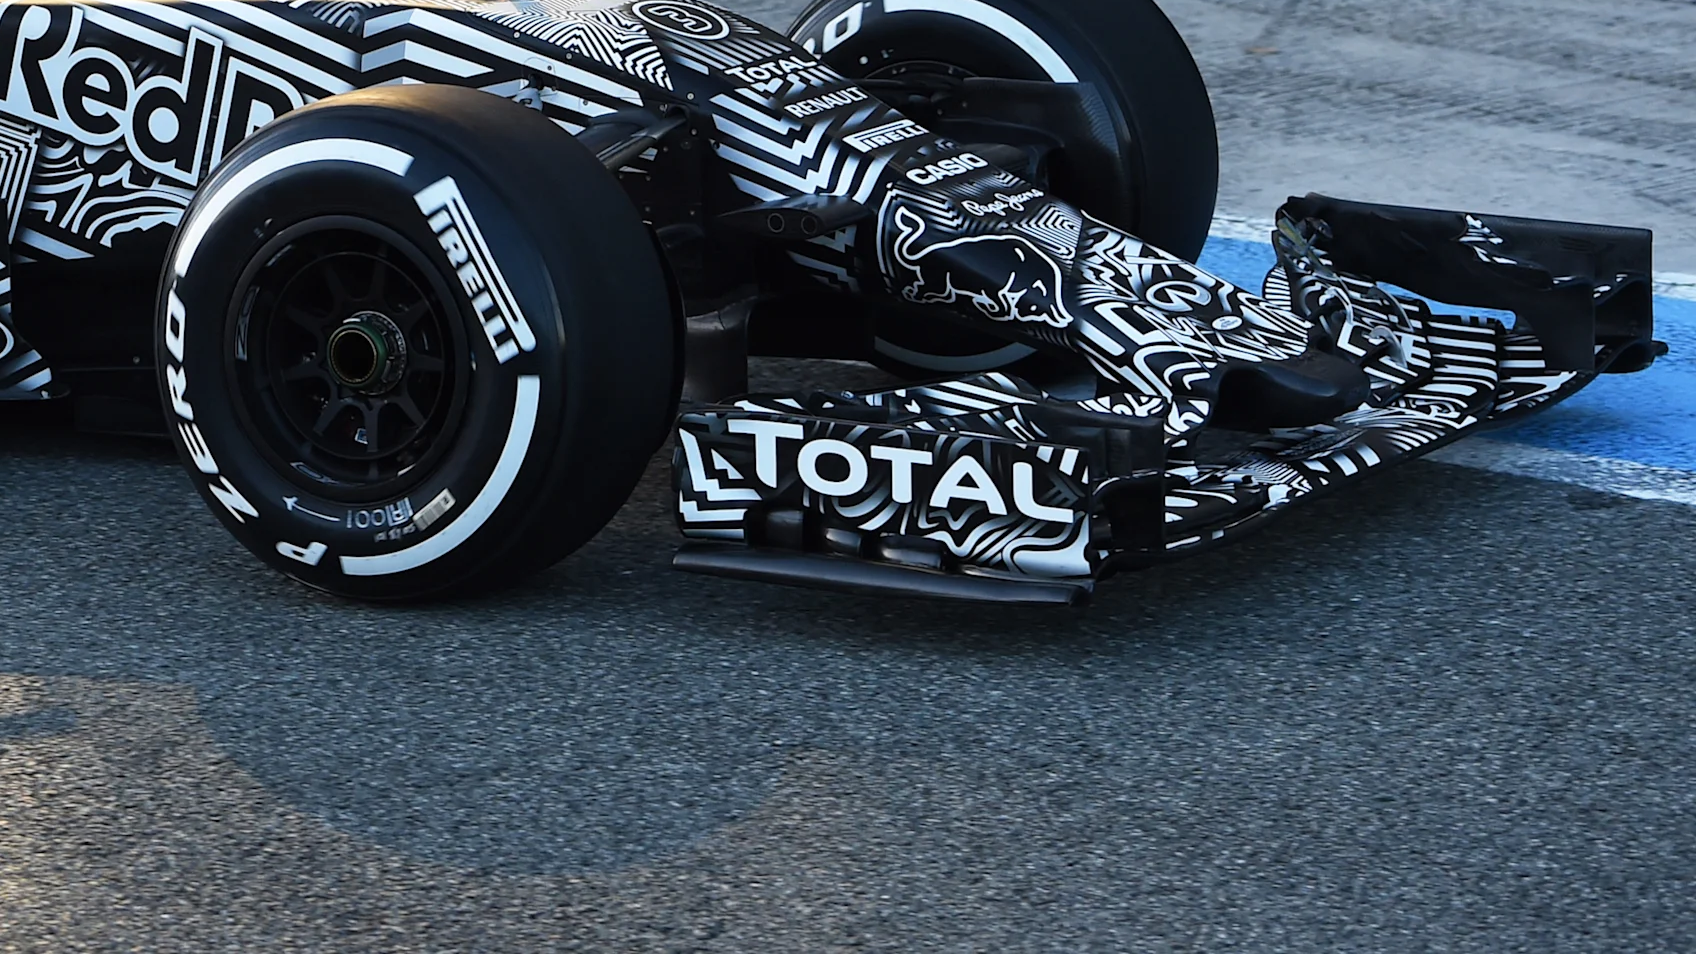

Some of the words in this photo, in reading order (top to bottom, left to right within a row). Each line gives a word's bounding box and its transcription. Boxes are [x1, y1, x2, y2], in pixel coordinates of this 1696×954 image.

[724, 55, 822, 84] TOTAL
[784, 86, 869, 119] RENAULT
[842, 119, 930, 153] PIRELLI
[906, 151, 989, 185] CASIO
[413, 176, 537, 365] PIRELLI
[164, 288, 260, 525] ZERO
[727, 419, 1076, 524] TOTAL
